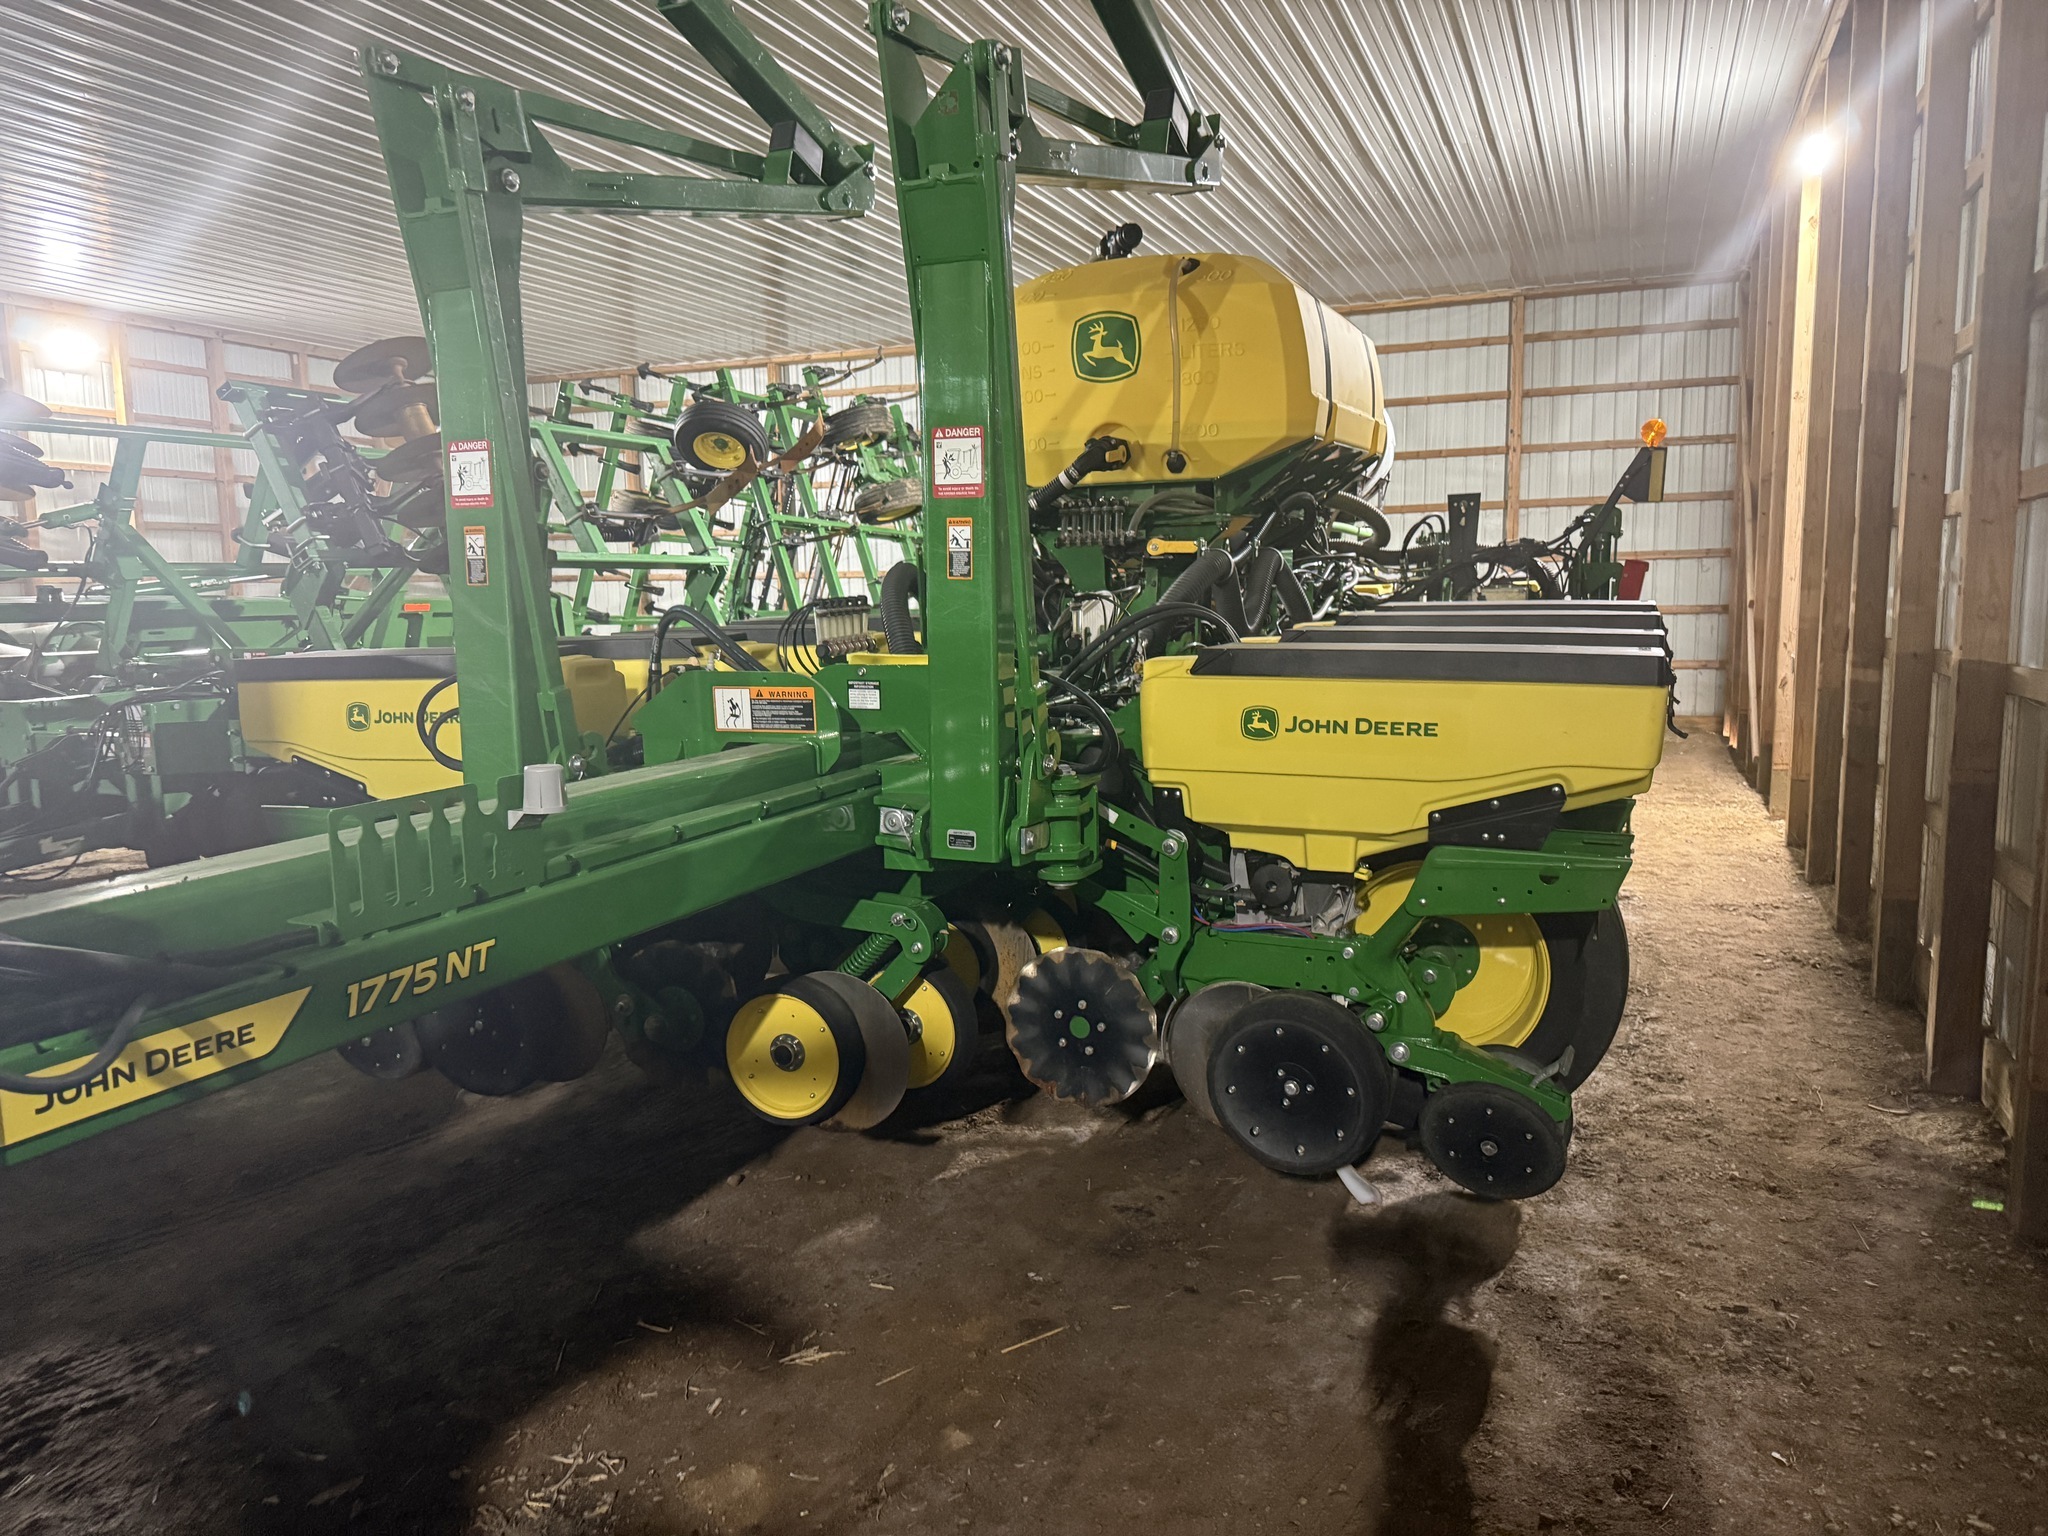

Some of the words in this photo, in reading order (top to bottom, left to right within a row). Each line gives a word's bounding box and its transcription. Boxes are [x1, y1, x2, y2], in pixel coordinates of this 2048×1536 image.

[1180, 342, 1246, 360] LITERS
[945, 427, 981, 438] DANGER
[458, 441, 488, 450] DANGER
[768, 690, 808, 698] WARNING
[374, 709, 414, 724] JOHN
[1284, 715, 1349, 735] JOHN
[1355, 717, 1439, 738] DEERE
[346, 956, 439, 1019] 1775
[444, 938, 497, 985] NT
[145, 1022, 256, 1078] DEERE
